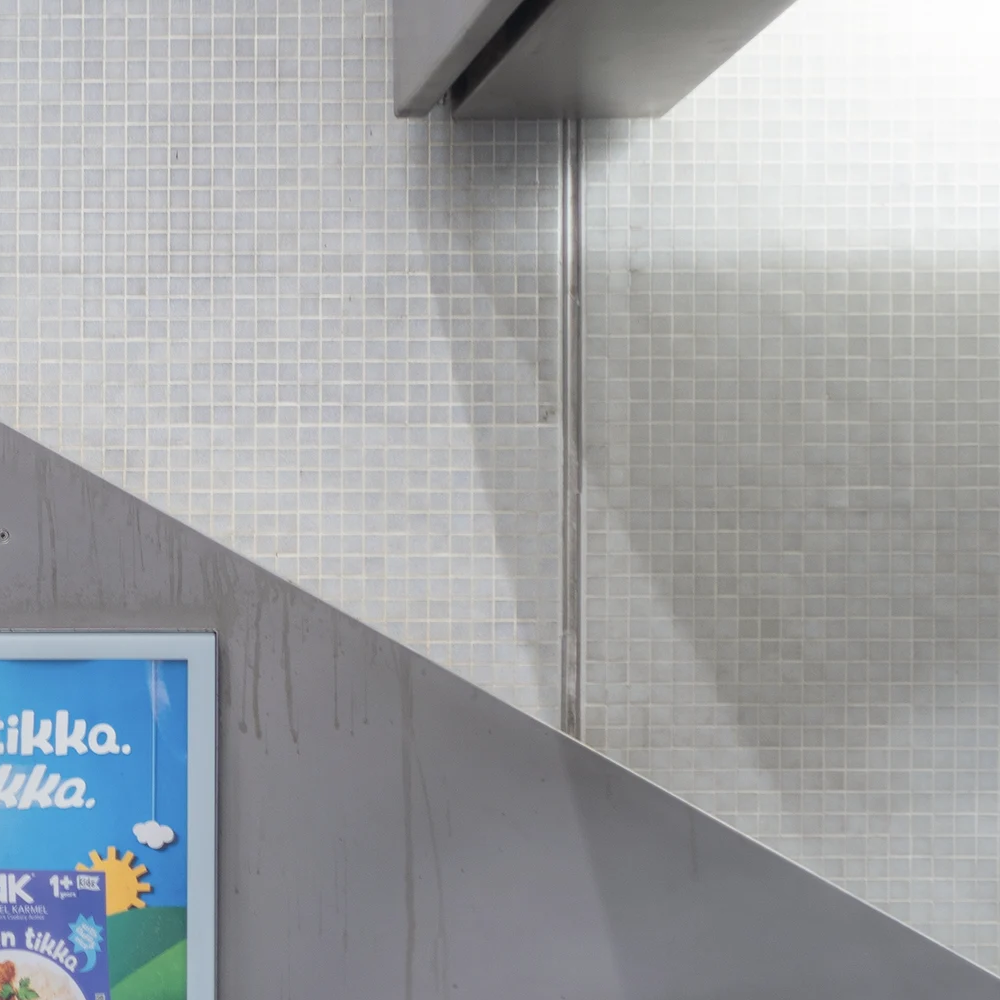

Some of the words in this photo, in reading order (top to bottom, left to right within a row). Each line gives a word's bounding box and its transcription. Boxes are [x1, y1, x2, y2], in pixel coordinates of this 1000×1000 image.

[49, 874, 74, 898] 1+
[12, 904, 48, 915] KARMEL
[24, 926, 79, 974] tikka
